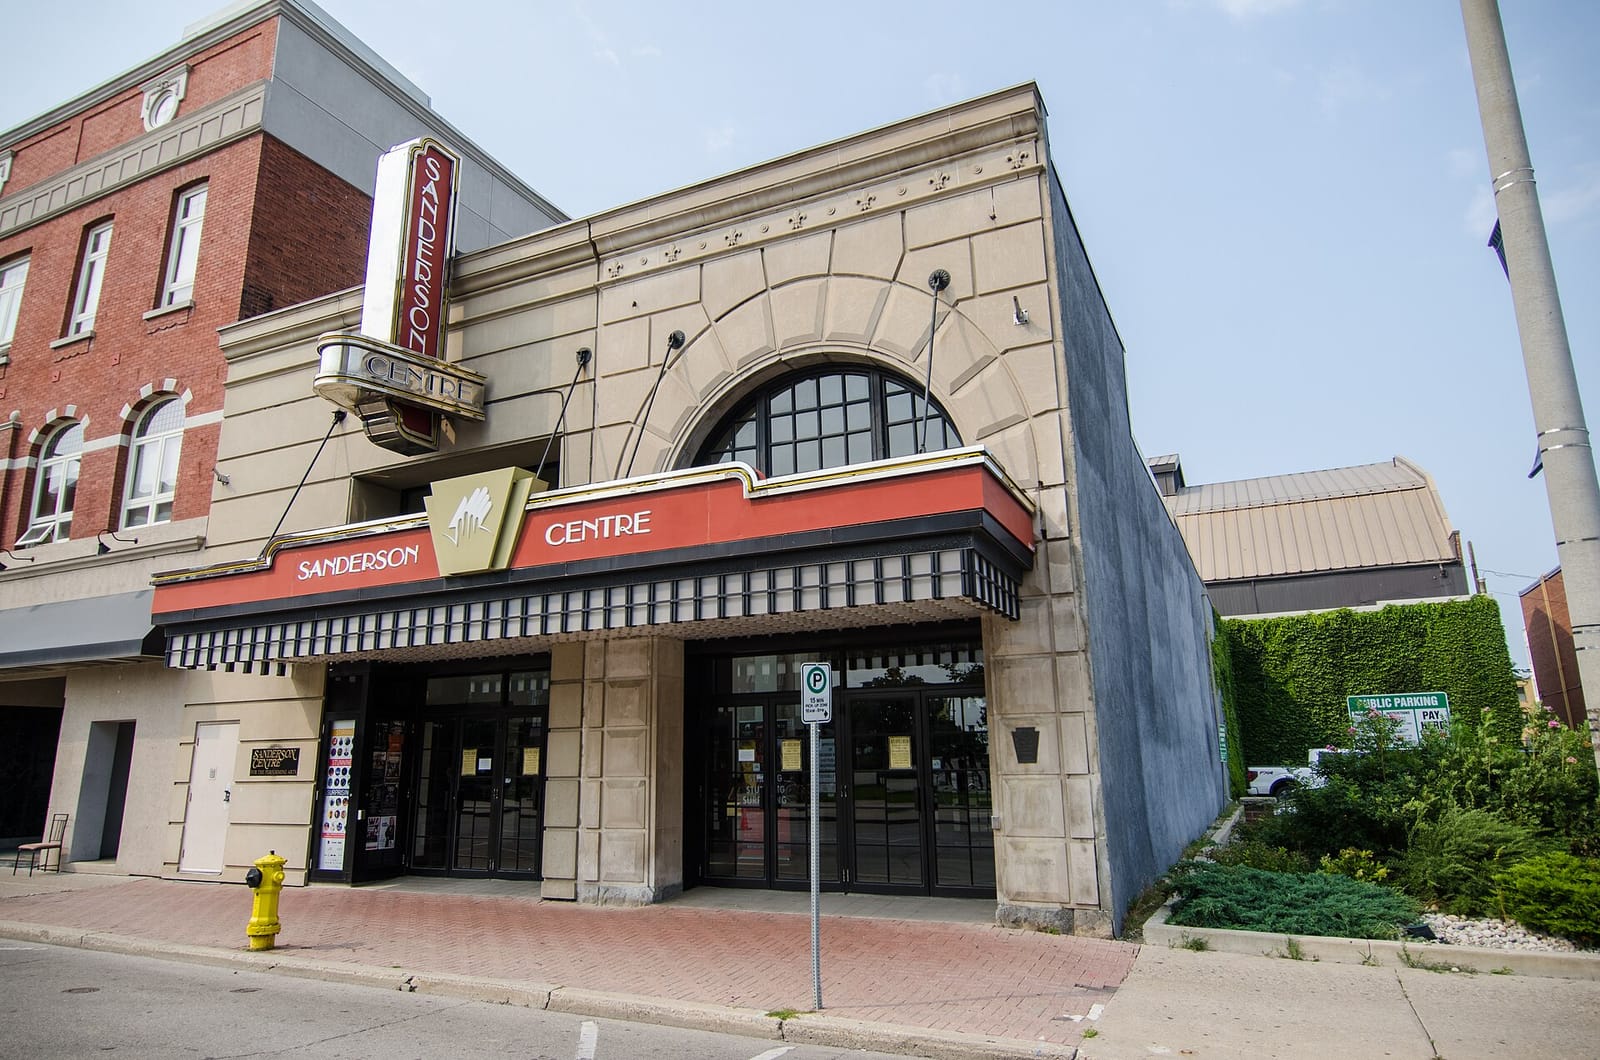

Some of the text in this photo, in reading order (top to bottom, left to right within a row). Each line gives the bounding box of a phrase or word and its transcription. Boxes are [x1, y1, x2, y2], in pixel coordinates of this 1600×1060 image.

[408, 157, 441, 354] SANDERSON
[366, 356, 474, 404] CENTRE
[297, 510, 652, 581] SANDERSON CENTRE
[813, 673, 822, 687] P
[1359, 695, 1438, 708] UBLIC PARKING
[1422, 710, 1440, 720] PAY
[253, 749, 297, 760] SANDERSON
[252, 758, 281, 769] CENTRE
